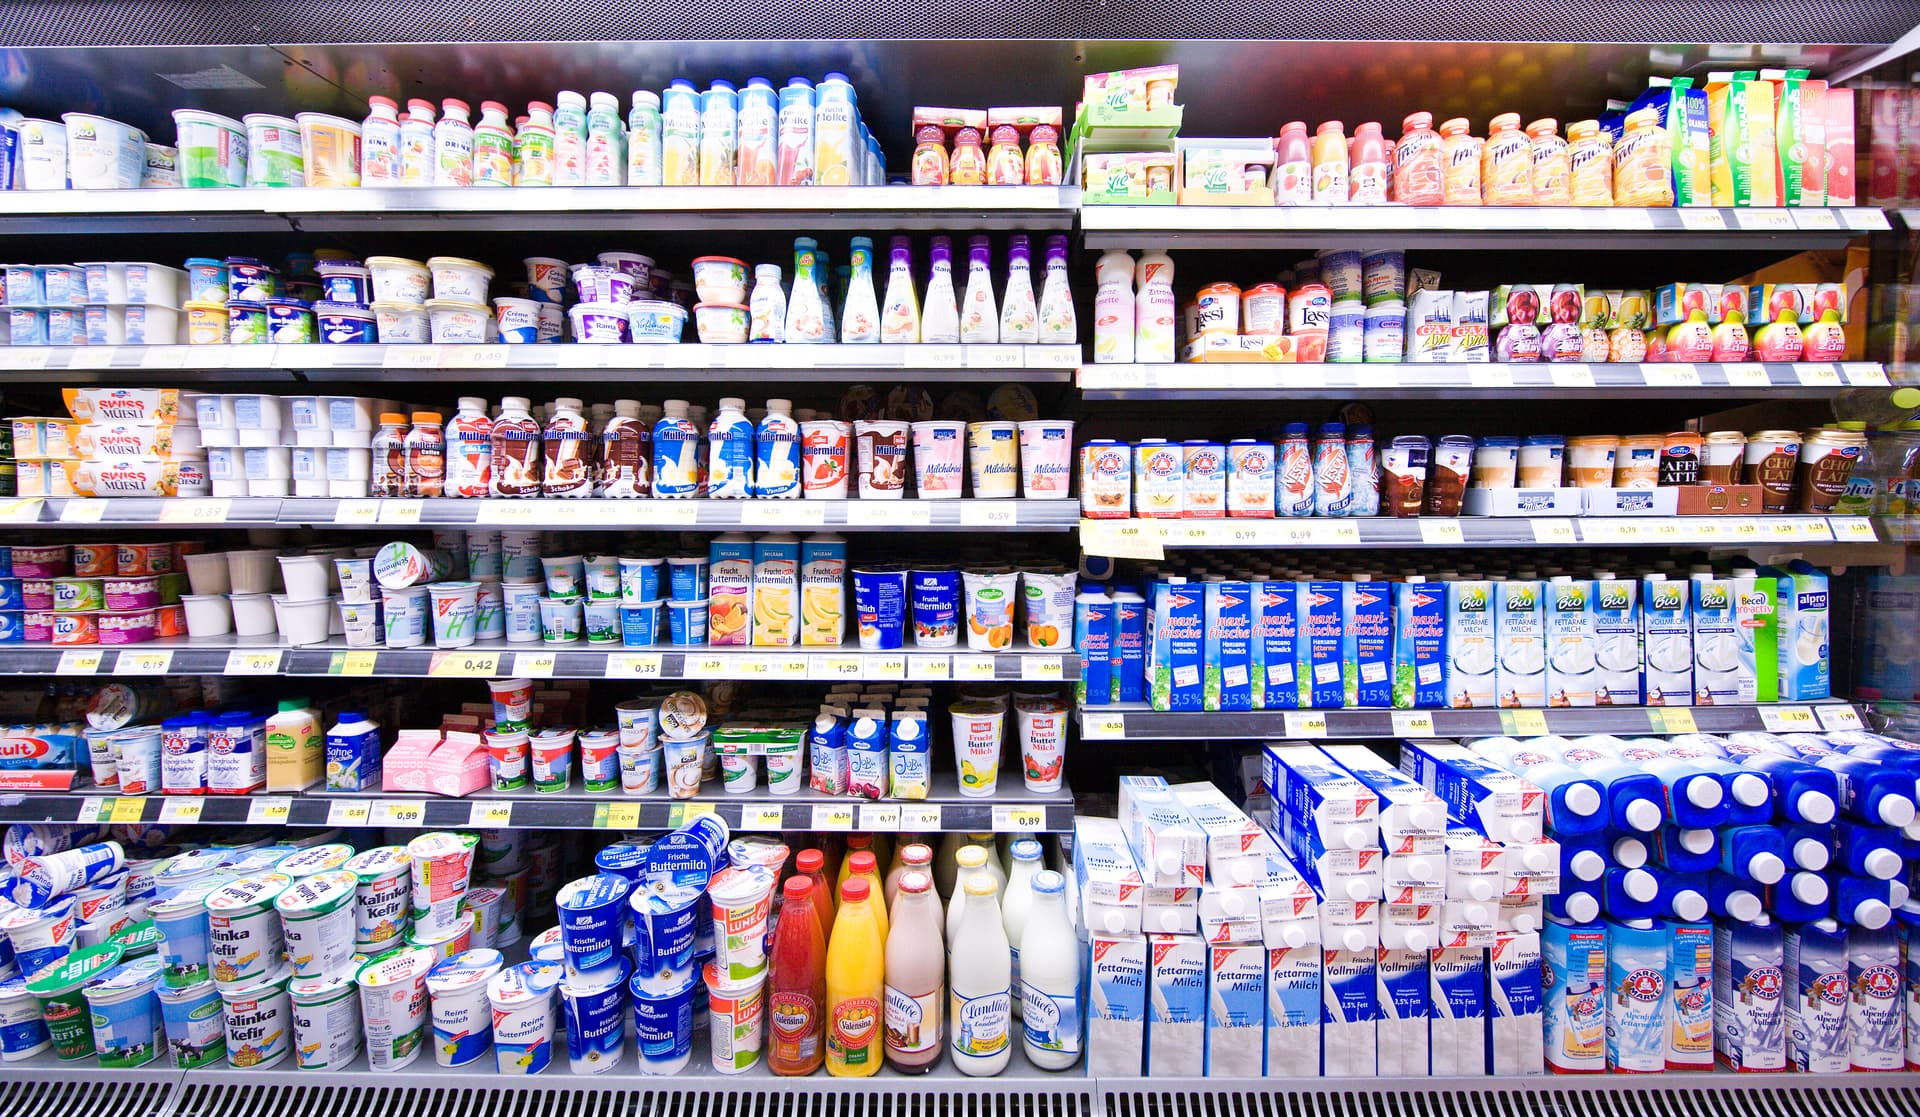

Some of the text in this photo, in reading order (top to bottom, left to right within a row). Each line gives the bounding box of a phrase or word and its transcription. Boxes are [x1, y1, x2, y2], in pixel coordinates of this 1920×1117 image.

[596, 322, 616, 331] Rama
[99, 400, 144, 410] SWISS
[103, 410, 144, 419] MÜESLI
[100, 437, 141, 446] SWISS
[104, 446, 141, 455] MÜESLI
[100, 472, 146, 481] SWISS
[105, 482, 146, 490] MÜESLI
[550, 484, 575, 493] Schoko
[803, 575, 842, 584] Buttermilch
[1462, 595, 1483, 609] Bio
[1509, 595, 1531, 609] Bio
[1559, 595, 1582, 609] Bio
[1602, 594, 1625, 607] Bio
[1655, 594, 1679, 607] Bio
[1702, 594, 1725, 607] Bio
[1741, 596, 1765, 606] Becel
[1799, 593, 1826, 605] alpro
[1650, 616, 1685, 626] VOLLMILCH
[1698, 616, 1733, 625] VOLLMILCH
[143, 661, 164, 669] 0,19
[253, 661, 274, 669] 0,19
[464, 660, 492, 671] 0,42
[635, 664, 656, 673] 0,35
[838, 665, 858, 673] 1,29
[969, 734, 992, 742] Frucht
[1031, 730, 1055, 738] Frucht
[968, 740, 993, 748] Butter
[970, 747, 992, 755] Milch
[397, 812, 418, 820] 0,99
[1019, 817, 1039, 826] 0,89
[651, 862, 707, 871] Buttermilch
[357, 885, 407, 906] Kalinka
[368, 903, 400, 919] Kefir
[1120, 957, 1143, 966] Frische
[1180, 958, 1203, 966] Frische
[1296, 961, 1319, 969] Frische
[1380, 961, 1427, 972] Vollmilch
[1494, 959, 1541, 971] Vollmilch
[1097, 963, 1143, 975] fettarme
[1156, 967, 1204, 977] fettarme
[1327, 966, 1375, 976] Vollmilch
[1434, 962, 1482, 973] Vollmilch
[1216, 971, 1262, 982] fettarme
[1274, 969, 1319, 979] fettarme
[1112, 975, 1142, 987] Milch
[1172, 978, 1203, 988] Milch
[1288, 980, 1318, 990] Milch
[1232, 982, 1262, 992] Milch
[1866, 986, 1896, 997] MARKE
[1630, 987, 1662, 1000] MARKE
[445, 1008, 468, 1017] Reine
[225, 1009, 277, 1027] Kalinka
[521, 1015, 544, 1028] Reine
[775, 1013, 805, 1026] Valensina
[841, 1019, 872, 1031] Valensina
[230, 1027, 266, 1041] Kefir
